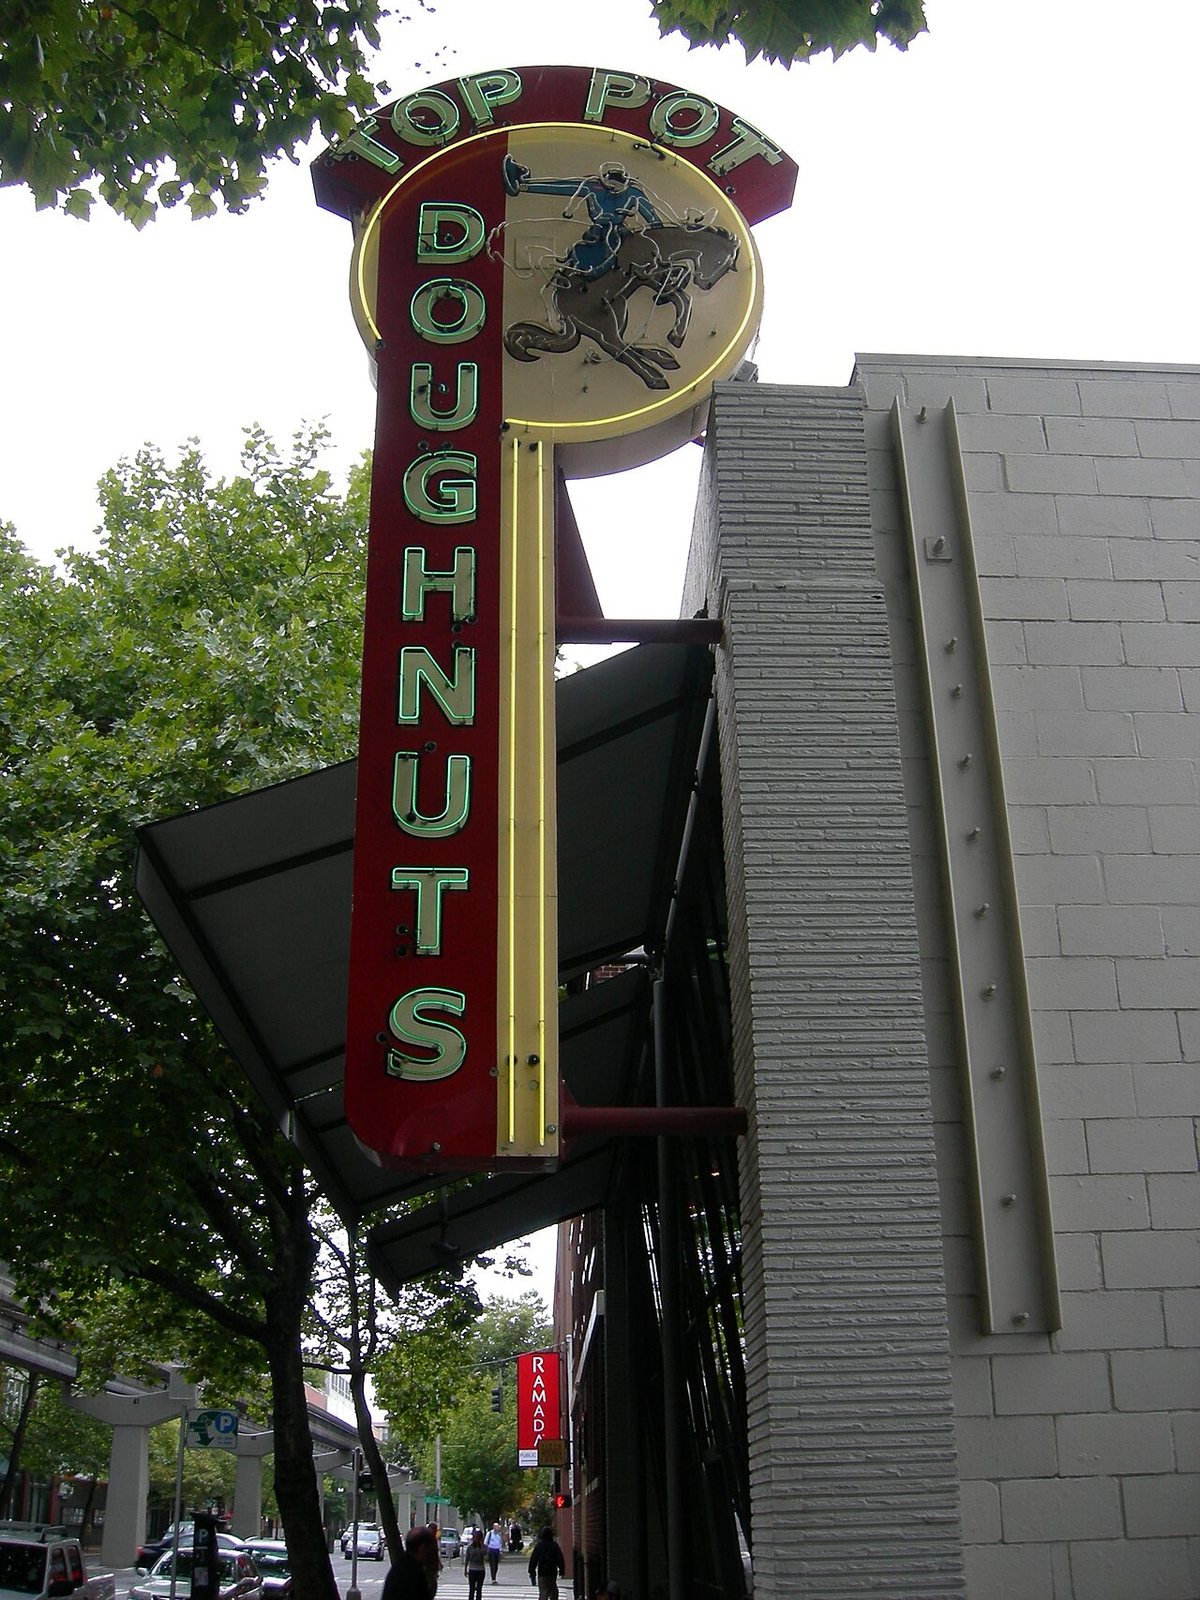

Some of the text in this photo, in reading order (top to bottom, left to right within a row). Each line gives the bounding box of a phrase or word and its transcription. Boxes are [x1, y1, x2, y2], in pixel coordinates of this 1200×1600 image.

[330, 66, 783, 177] TOP POT
[387, 202, 486, 1081] DOUGHNUTS
[220, 1415, 232, 1431] P
